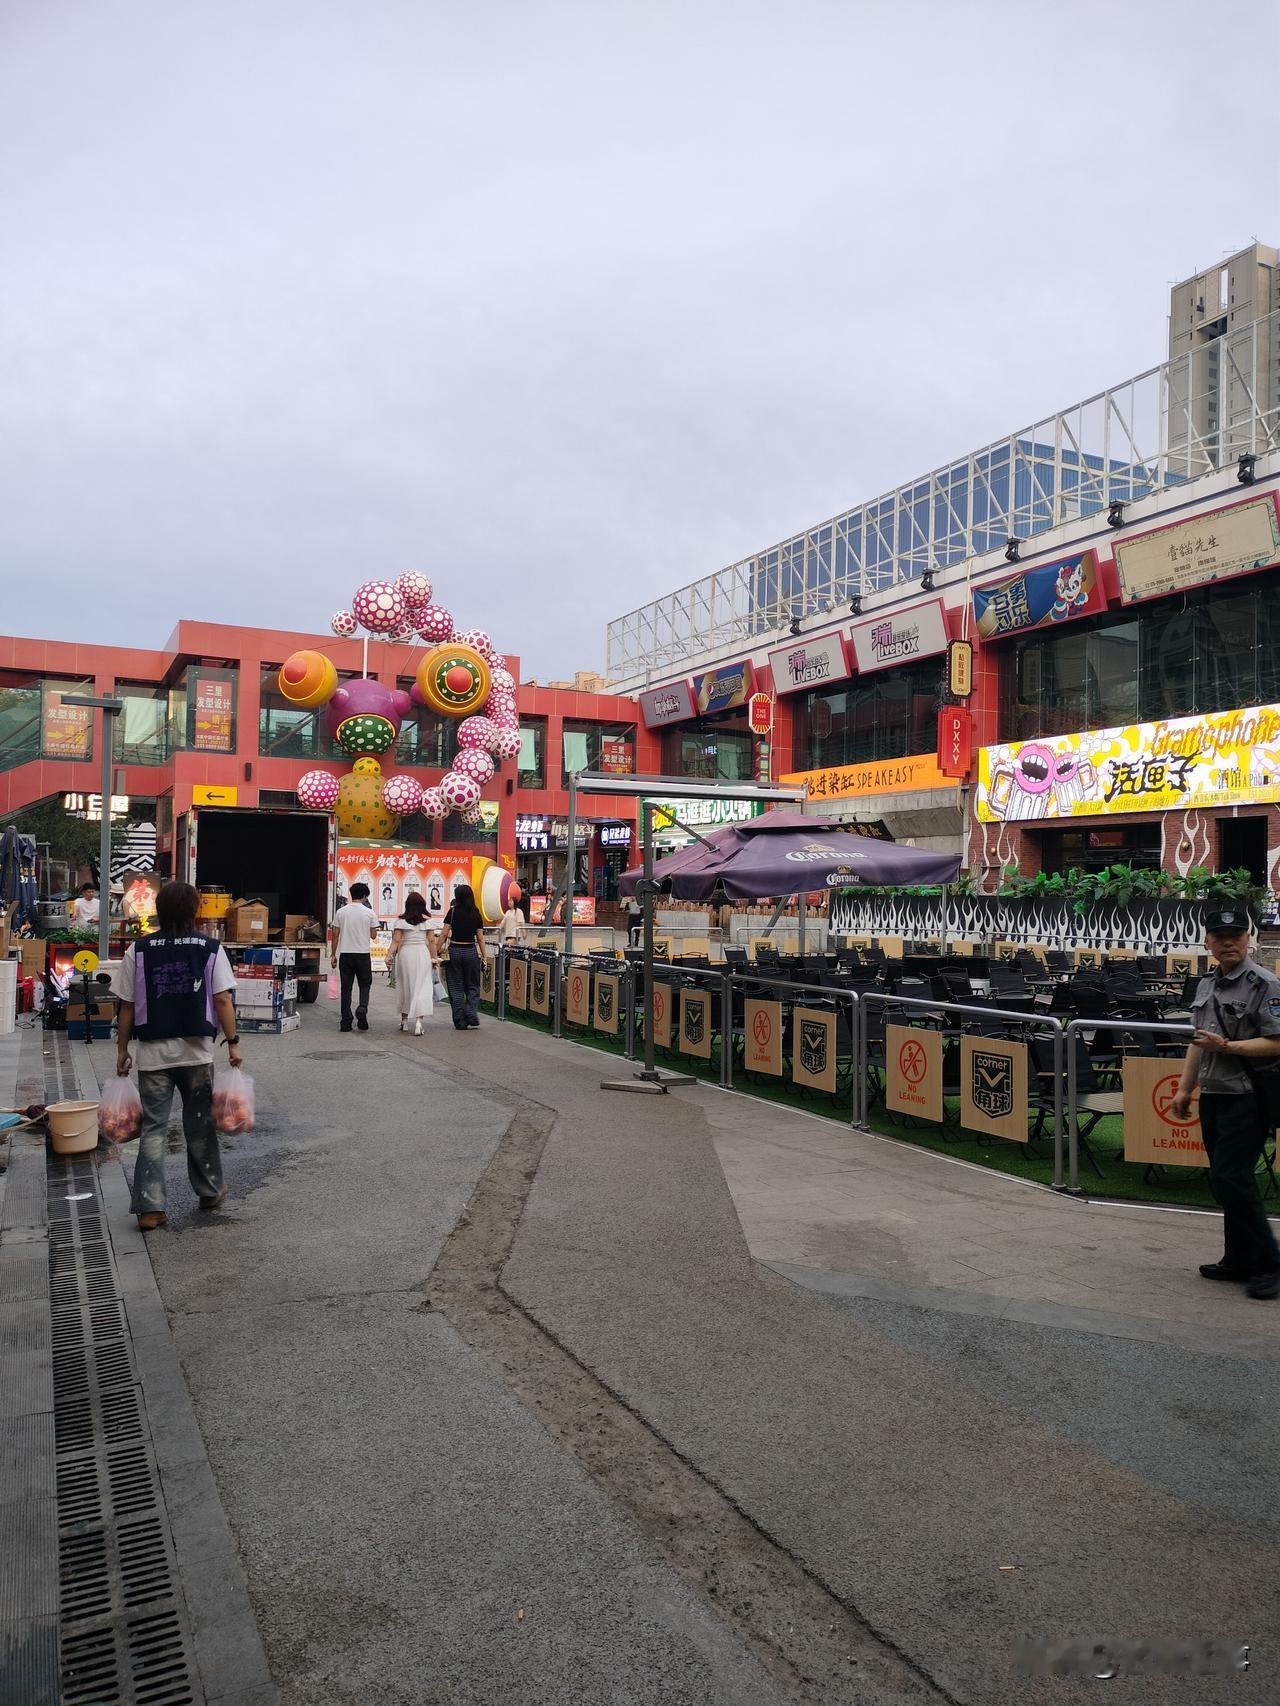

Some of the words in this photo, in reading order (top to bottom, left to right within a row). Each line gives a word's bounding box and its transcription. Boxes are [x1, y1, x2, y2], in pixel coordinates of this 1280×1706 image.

[196, 696, 231, 710] 发型设计
[47, 708, 88, 721] 发型设计
[953, 719, 961, 765] DXXY
[603, 755, 632, 765] 发型设计
[857, 764, 914, 789] SPEAKEASY
[1104, 750, 1202, 803] 话匣子
[1217, 767, 1242, 789] 酒馆
[785, 851, 869, 862] Corona
[826, 872, 860, 886] Corona
[804, 1024, 825, 1035] corner
[752, 1053, 772, 1064] LEANING
[977, 1057, 1008, 1071] corner
[907, 1084, 917, 1093] NO
[898, 1091, 926, 1105] LEANING
[976, 1089, 1010, 1113] 角球
[1171, 1128, 1189, 1139] NO
